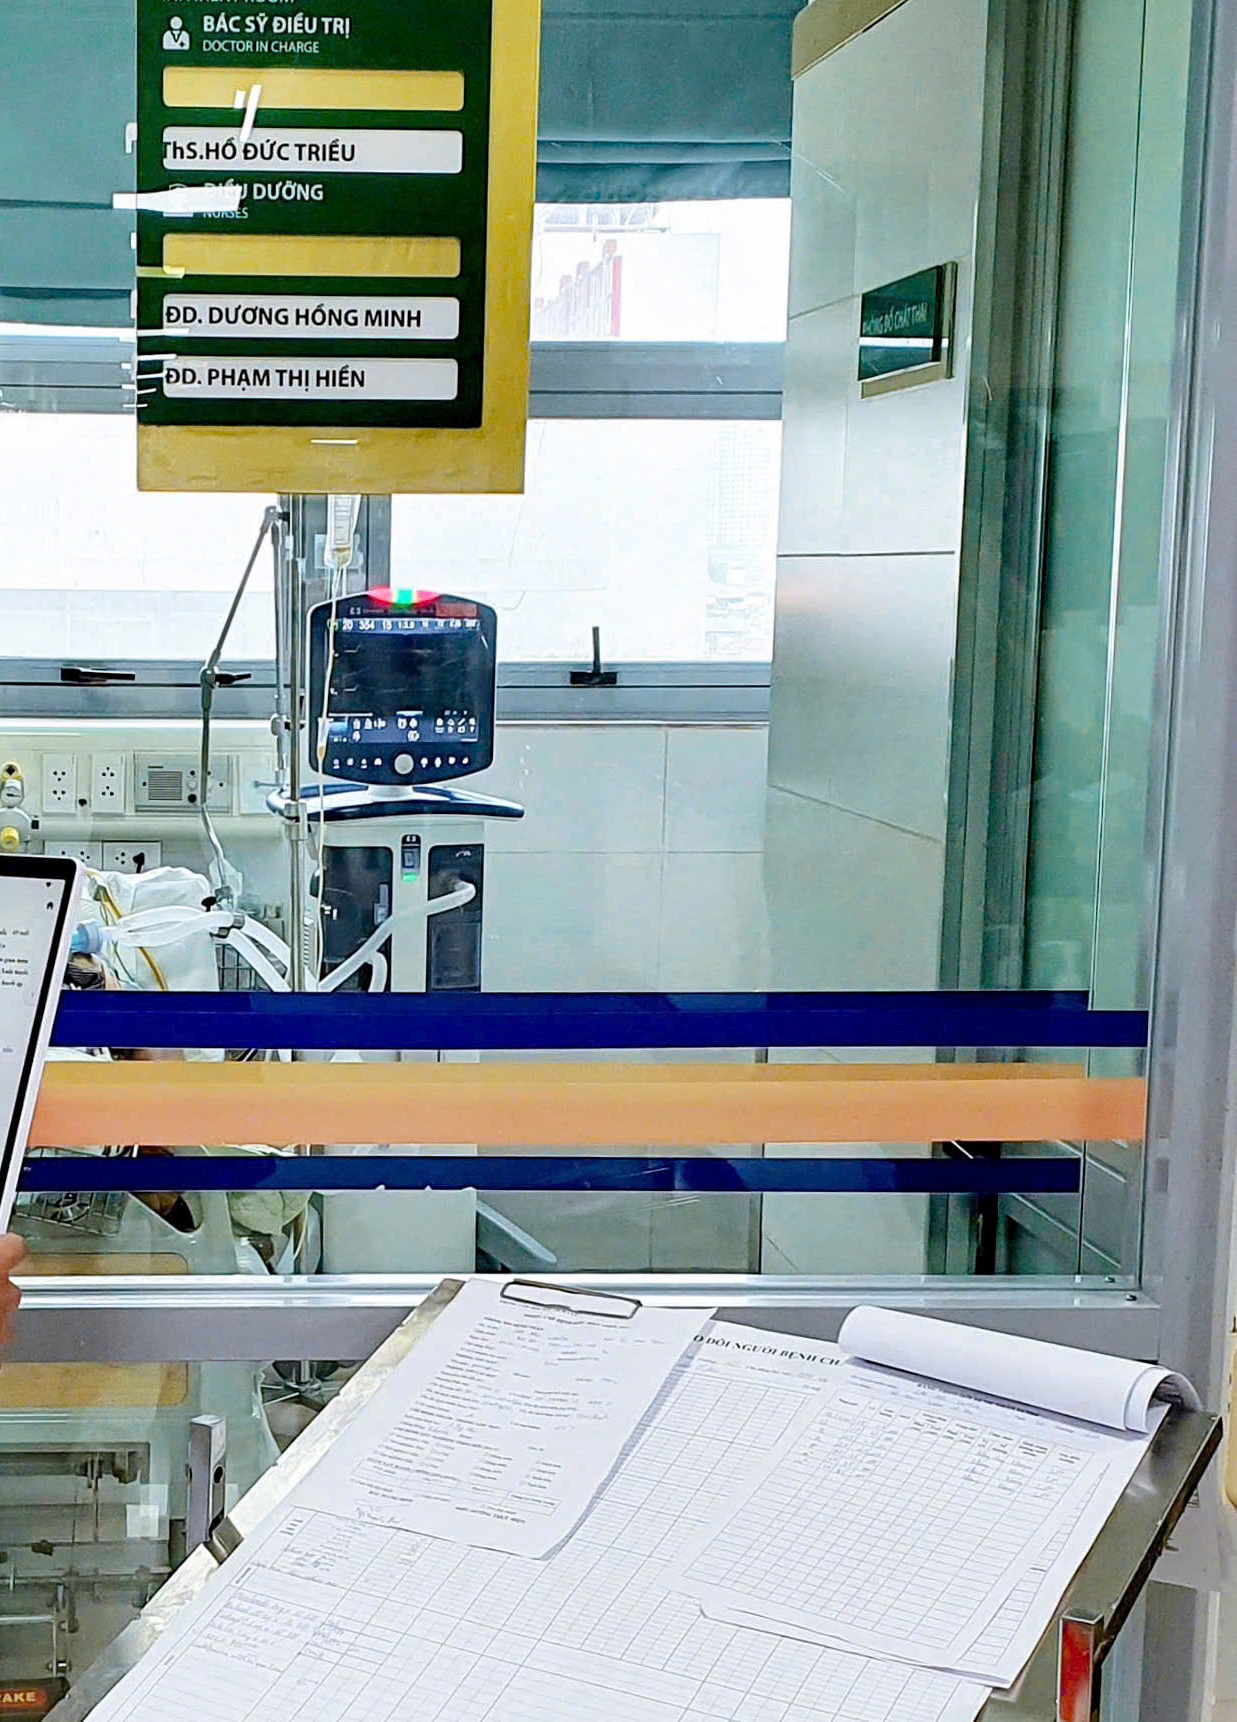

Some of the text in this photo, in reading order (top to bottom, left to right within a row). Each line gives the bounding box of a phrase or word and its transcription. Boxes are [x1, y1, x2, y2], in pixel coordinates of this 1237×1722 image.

[203, 12, 241, 33] BÁC
[245, 13, 269, 33] SỸ
[321, 17, 350, 39] TRỊ
[203, 40, 319, 53] DOCTOR IN CHARGE
[242, 138, 290, 161] ĐỨC
[253, 180, 324, 200] DƯỠNG
[166, 306, 202, 324] ĐD.
[209, 305, 289, 325] DƯƠNG
[364, 309, 421, 328] MINH
[165, 368, 201, 385] ĐD.
[208, 369, 270, 391] PHẠM
[276, 370, 310, 391] THỊ
